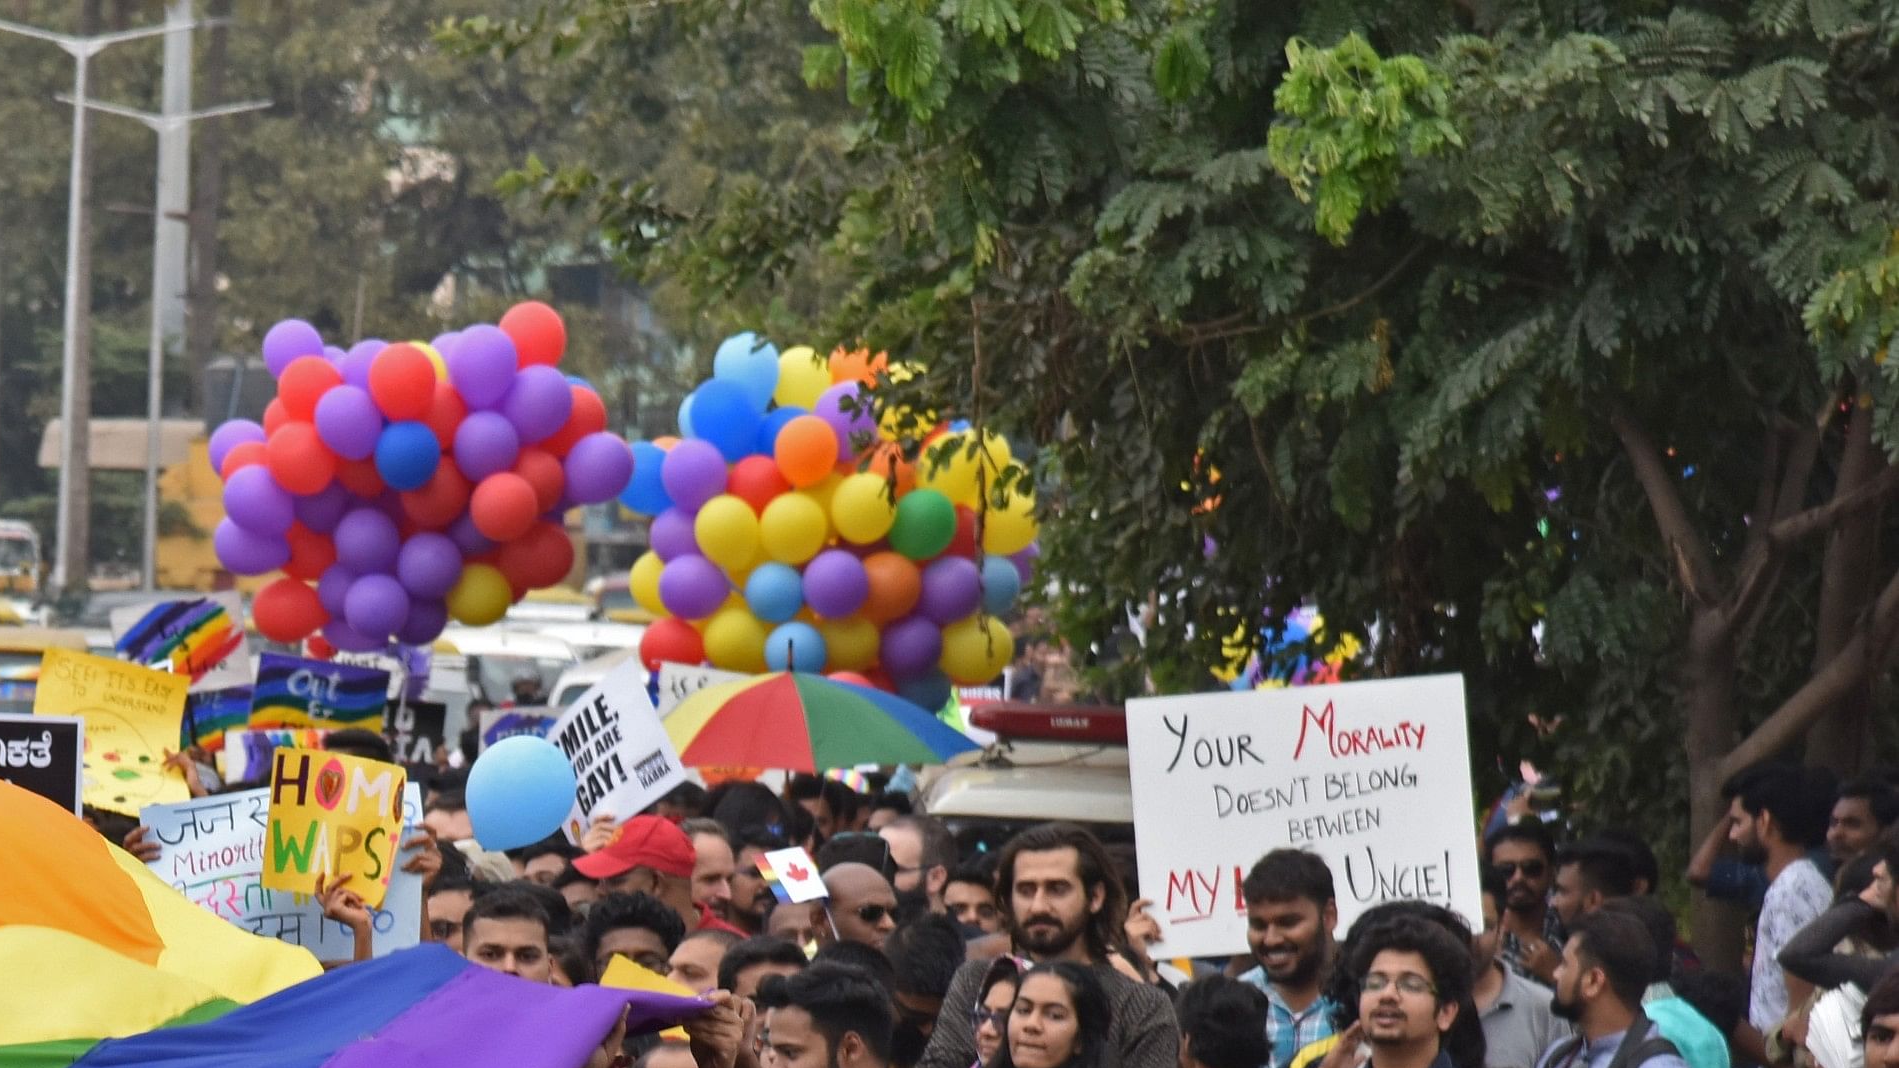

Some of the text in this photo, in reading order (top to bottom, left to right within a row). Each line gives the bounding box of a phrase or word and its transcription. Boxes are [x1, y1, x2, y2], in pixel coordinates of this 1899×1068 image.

[287, 668, 342, 704] Out
[554, 694, 619, 761] MILE,
[573, 747, 594, 780] OU
[594, 724, 623, 758] ARE
[1162, 699, 1426, 773] YOUR MORALITY
[273, 754, 405, 824] HOMO
[576, 751, 629, 817] GAY!
[1213, 763, 1418, 819] DOESN'T BELONG
[173, 831, 265, 878] Minorit
[1287, 807, 1381, 844] BETWEEN
[1166, 864, 1221, 914] MY
[1344, 846, 1453, 909] UNCLE!
